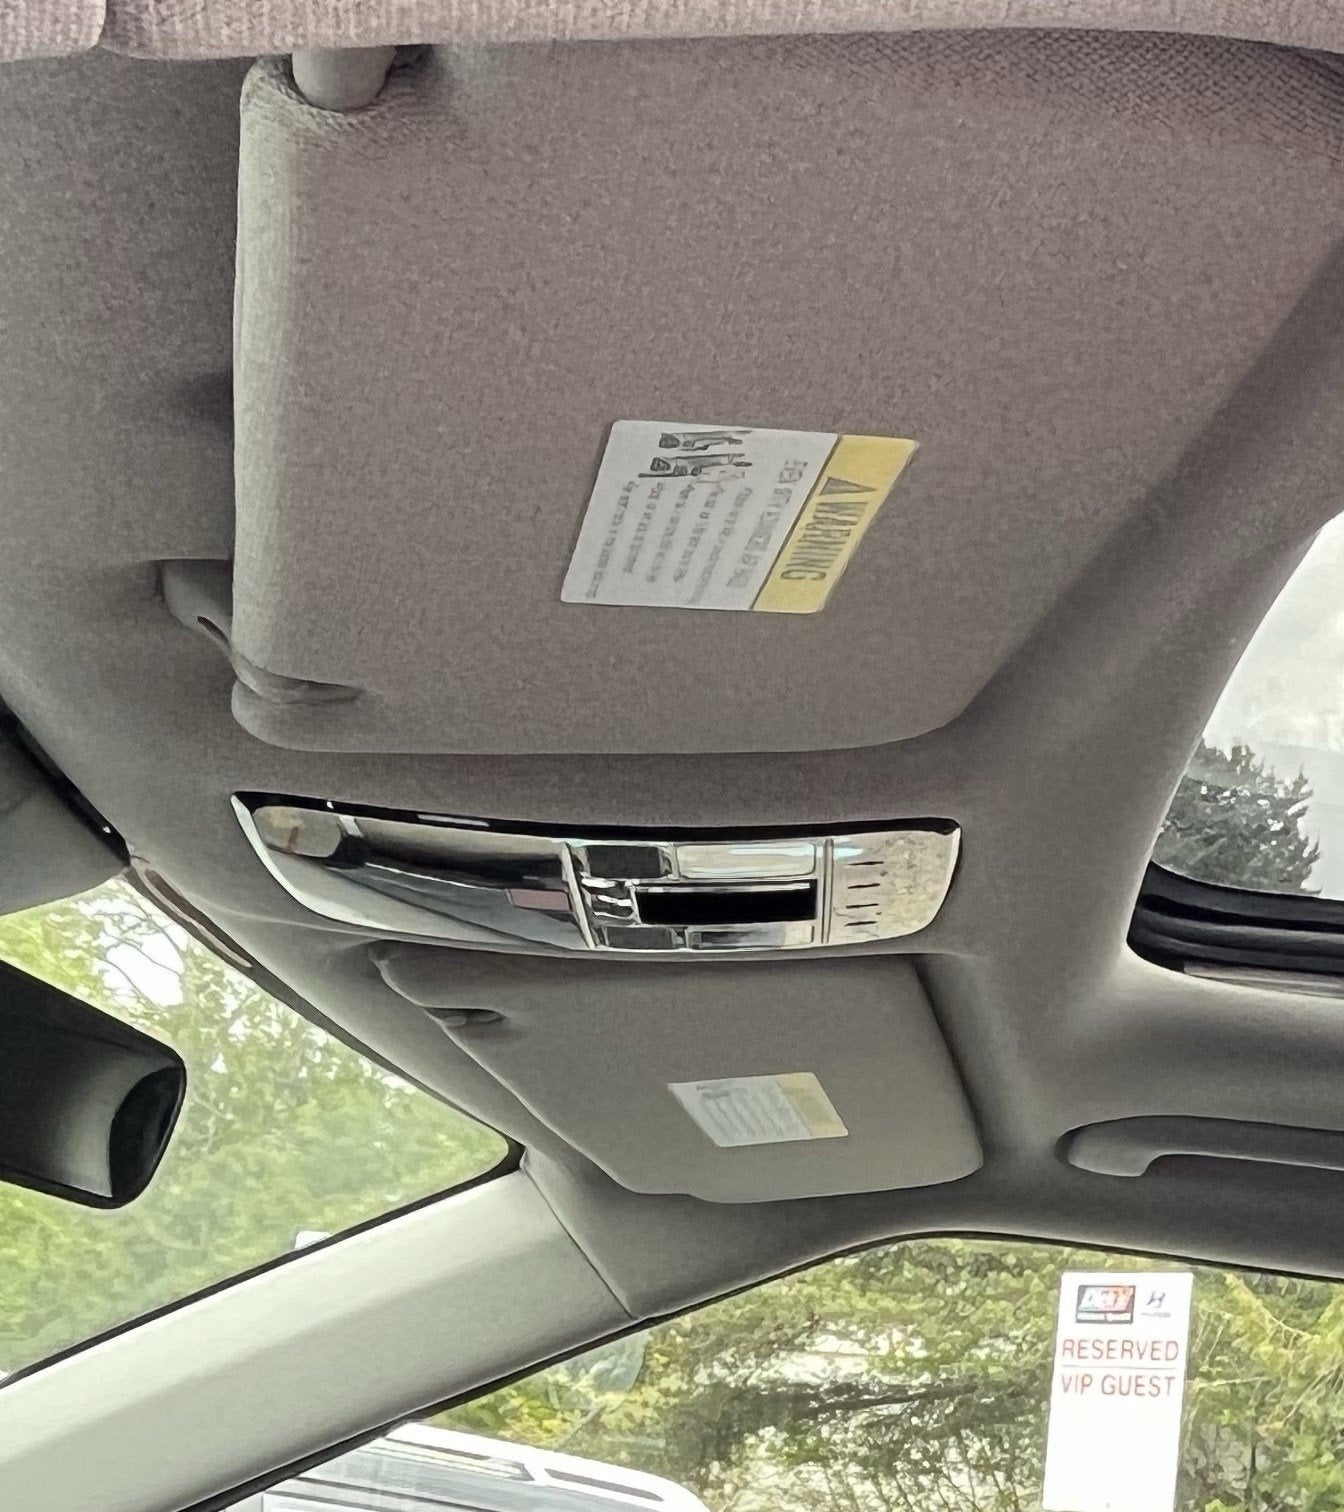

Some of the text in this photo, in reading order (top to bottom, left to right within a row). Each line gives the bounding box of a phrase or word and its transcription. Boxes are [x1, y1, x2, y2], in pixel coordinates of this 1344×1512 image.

[780, 501, 869, 580] WARNING
[1062, 1338, 1179, 1361] RESERVED
[1061, 1373, 1176, 1397] VIP GUEST
